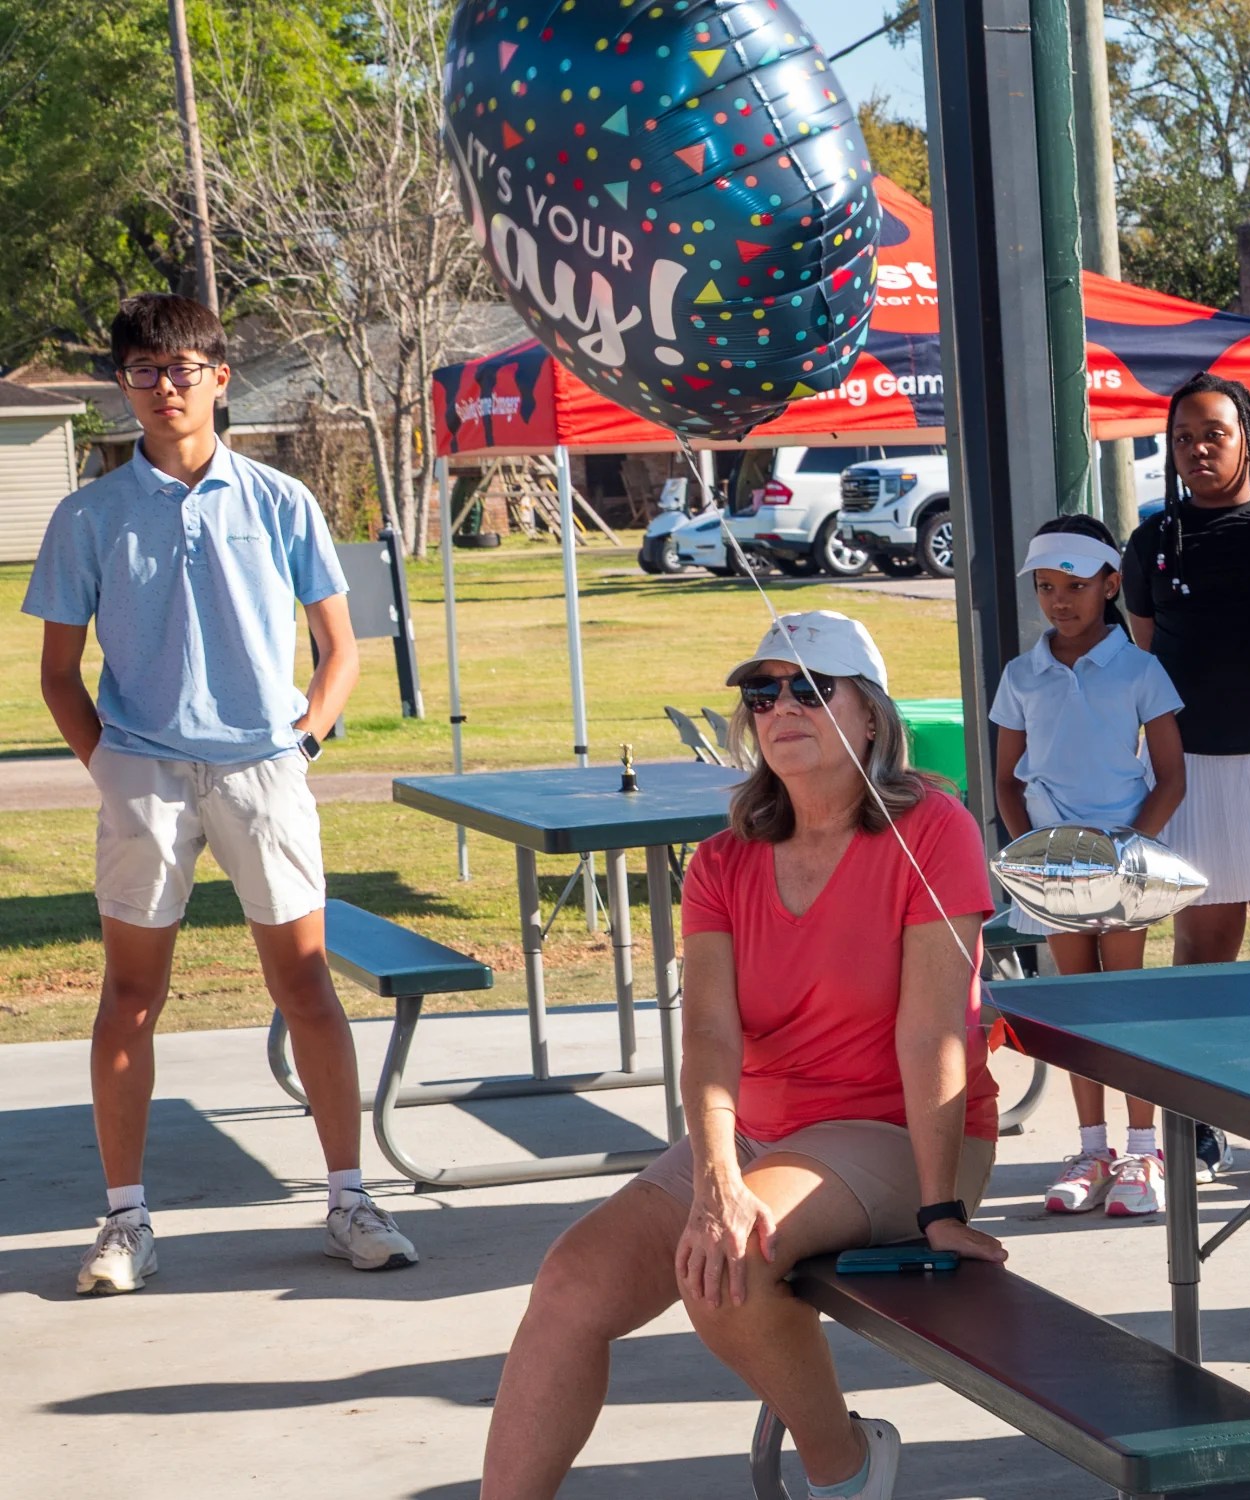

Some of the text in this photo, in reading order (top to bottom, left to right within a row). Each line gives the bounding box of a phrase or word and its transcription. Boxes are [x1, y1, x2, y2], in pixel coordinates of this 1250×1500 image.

[467, 131, 634, 272] IT'S YOUR
[873, 373, 944, 397] Gam
